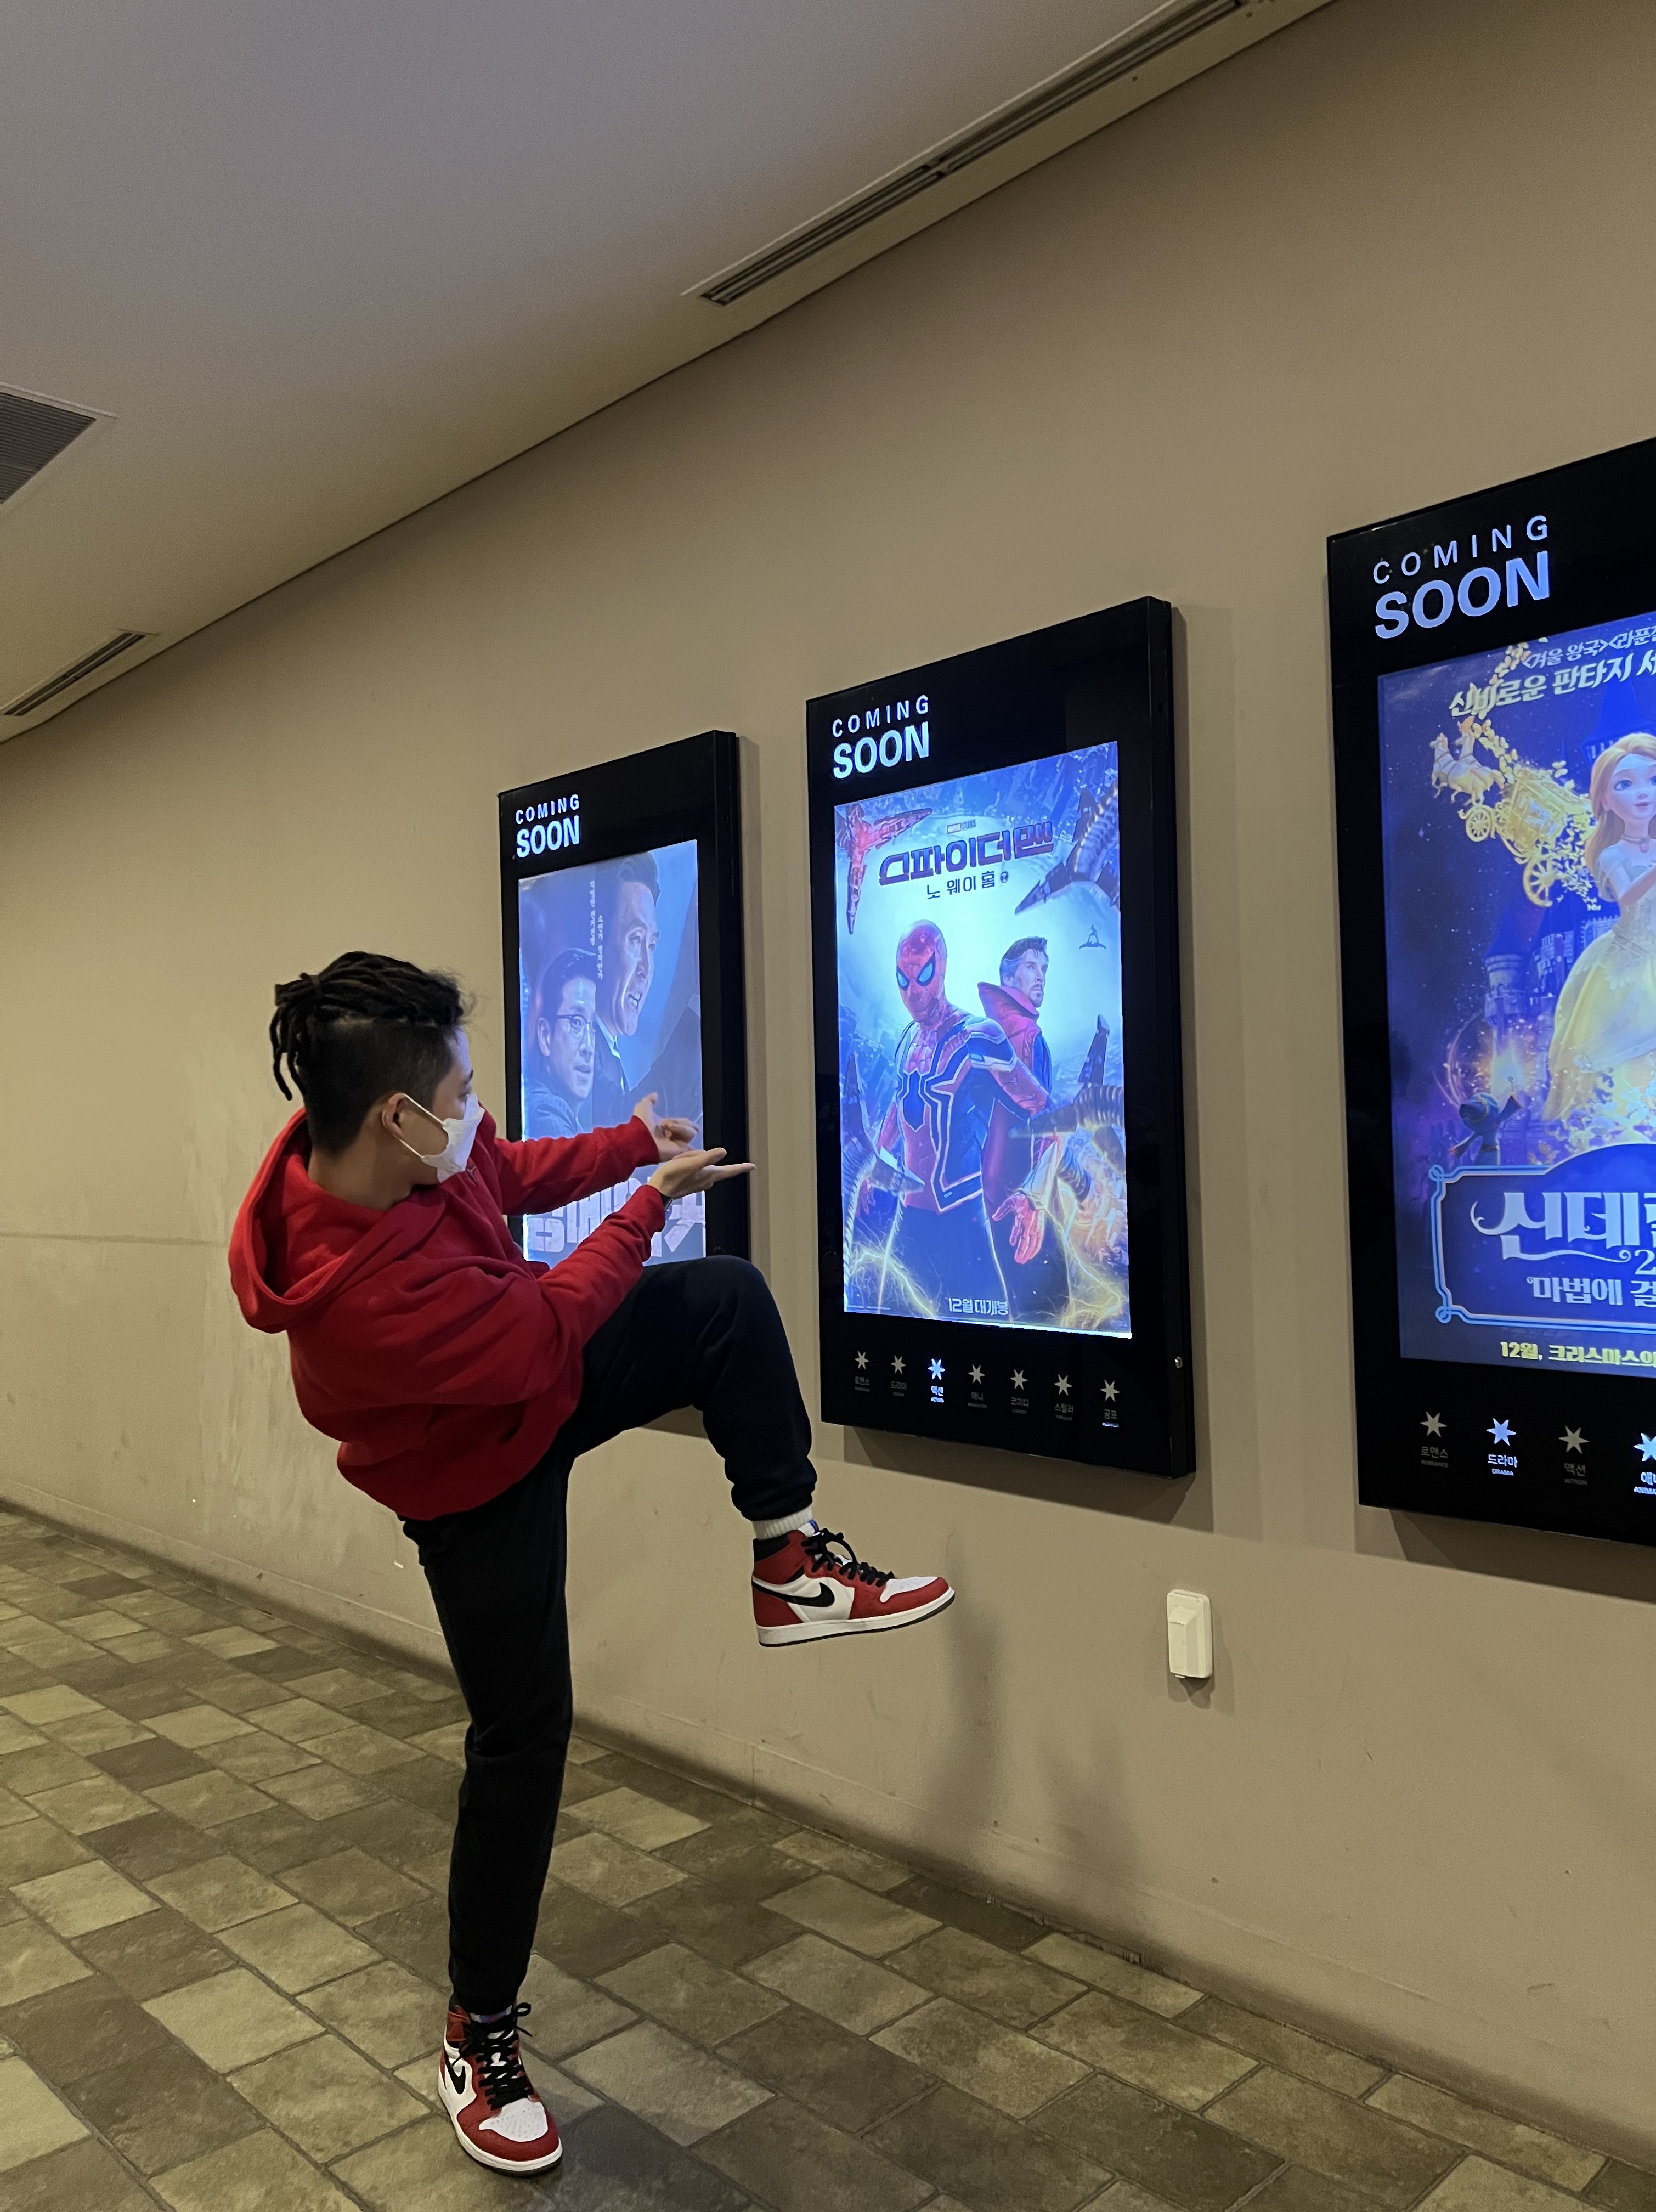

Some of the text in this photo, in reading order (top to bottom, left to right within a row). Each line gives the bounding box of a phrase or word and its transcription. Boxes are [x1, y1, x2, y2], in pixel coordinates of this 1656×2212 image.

[1373, 515, 1548, 583] COMING
[1375, 550, 1549, 639] SOON
[1449, 675, 1547, 719] 신비로운
[1552, 653, 1634, 695] 판타지
[832, 695, 929, 737] COMING
[833, 721, 929, 779] SOON
[516, 794, 579, 824] COMING
[517, 815, 580, 858] SOON
[879, 821, 1054, 885] 스파이더맨
[927, 871, 995, 899] 노 웨이 홈
[1634, 1249, 1655, 1275] 2
[1527, 1277, 1623, 1305] 마법에
[948, 1298, 1008, 1316] 12월 대개봉
[1054, 1403, 1074, 1414] 스릴러
[1104, 1409, 1117, 1419] 공포
[1421, 1446, 1449, 1458] 로맨스
[1487, 1454, 1518, 1468] 드라마
[1564, 1463, 1586, 1476] 액션
